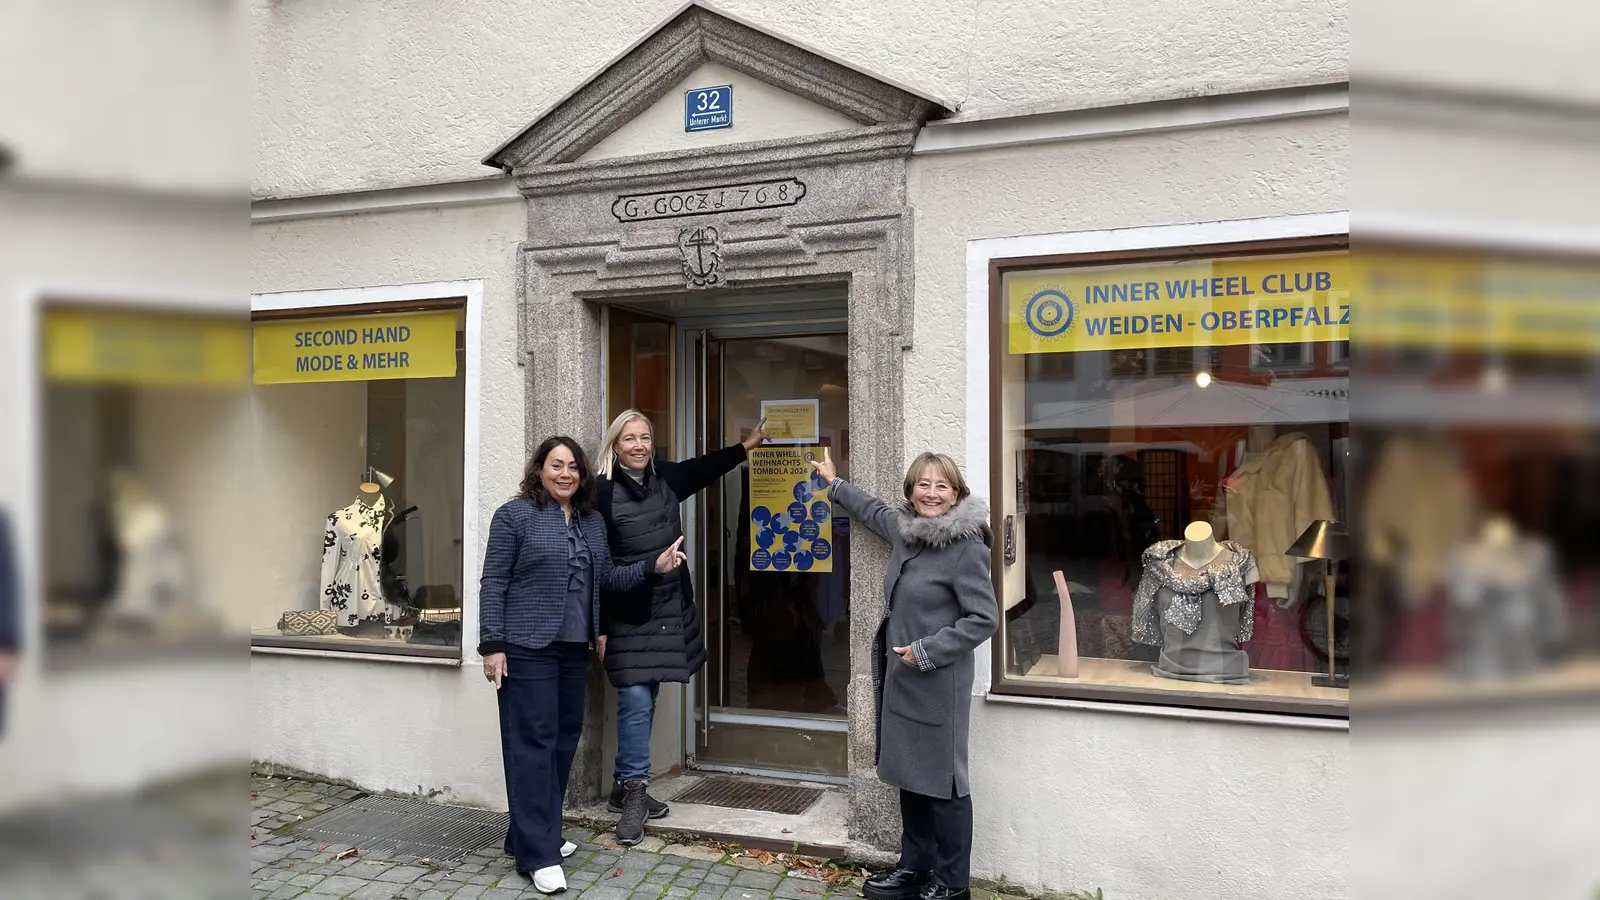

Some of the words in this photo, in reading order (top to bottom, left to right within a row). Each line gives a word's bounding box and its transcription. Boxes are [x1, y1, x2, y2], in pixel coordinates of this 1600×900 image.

[696, 90, 720, 111] 32
[690, 117, 709, 127] Unterer
[711, 113, 727, 124] Markt
[1085, 281, 1160, 305] INNER
[1165, 276, 1255, 300] WHEEL
[1261, 271, 1332, 294] CLUB
[1085, 313, 1183, 336] WEIDEN
[1200, 305, 1349, 331] OBERPFALZ
[295, 328, 358, 348] SECOND
[362, 326, 411, 344] HAND
[296, 355, 343, 373] MODE
[346, 353, 358, 370] &
[362, 351, 410, 370] MEHR
[776, 450, 801, 458] WHEEL
[752, 467, 789, 475] TOMBOLA
[790, 467, 808, 475] 2024
